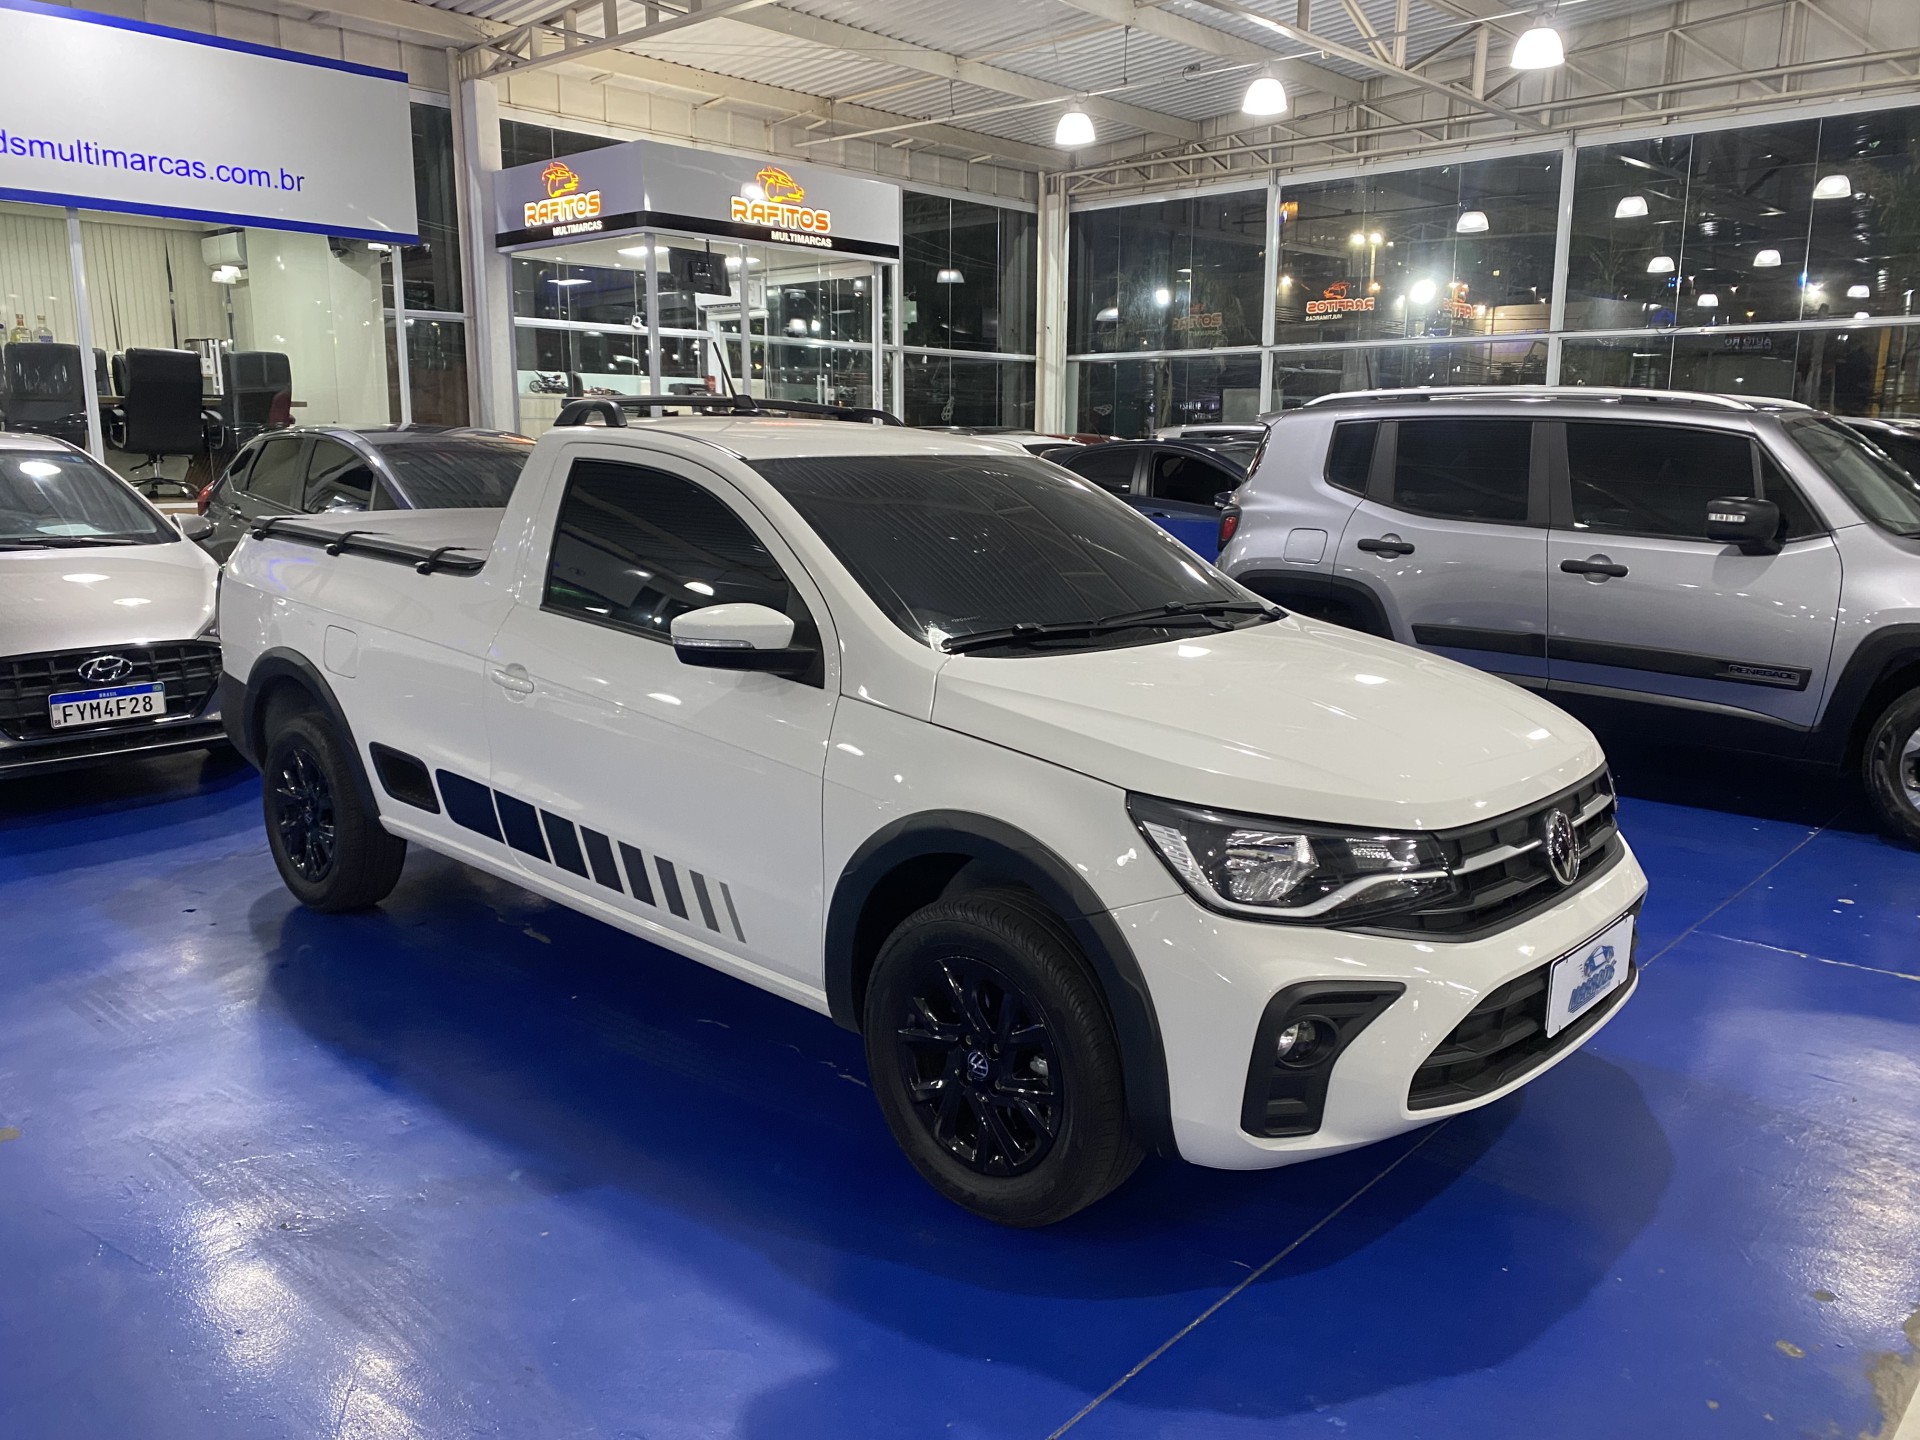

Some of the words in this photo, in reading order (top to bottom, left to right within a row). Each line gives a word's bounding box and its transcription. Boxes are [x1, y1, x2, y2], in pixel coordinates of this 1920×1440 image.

[524, 191, 600, 227] RAFITOS
[731, 196, 831, 234] RAFITOS
[553, 221, 602, 236] MULTIMARCAS
[771, 231, 832, 248] MULTIMARCAS
[1729, 666, 1797, 680] RENEGADE
[62, 696, 153, 723] FYM4F28
